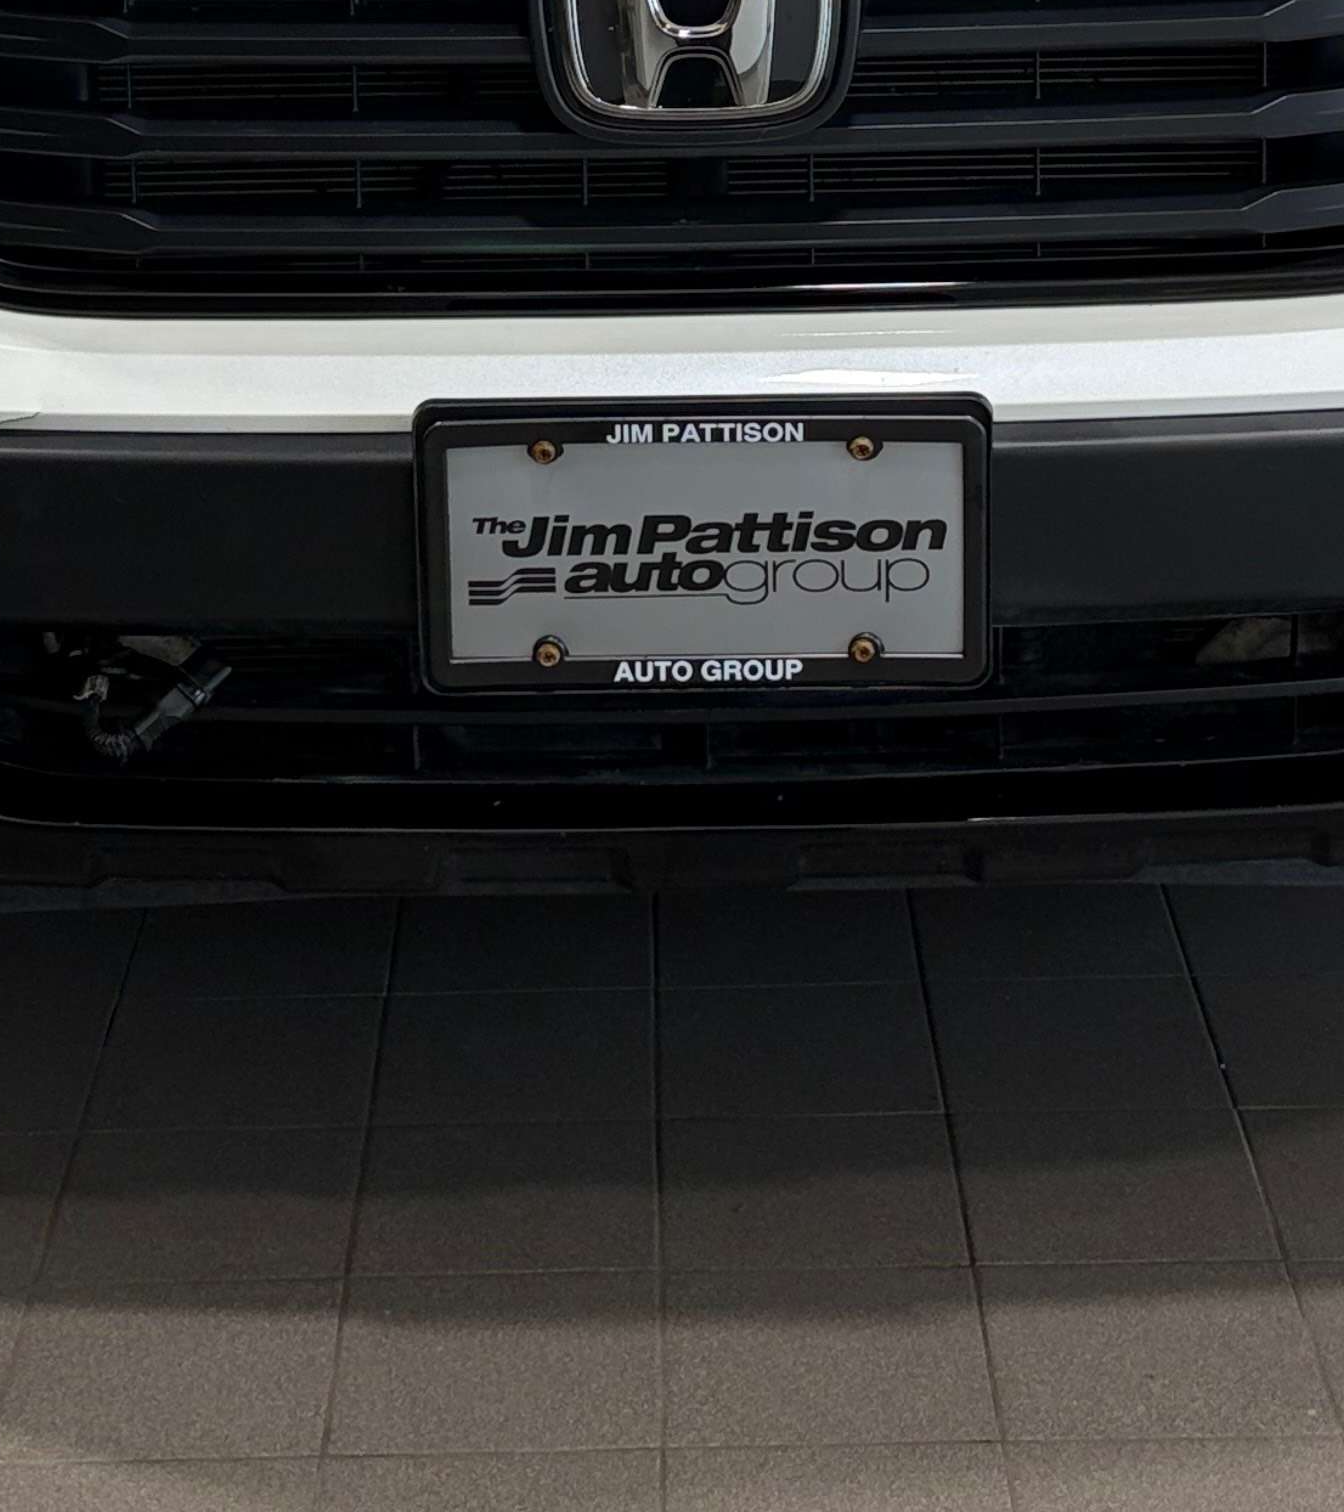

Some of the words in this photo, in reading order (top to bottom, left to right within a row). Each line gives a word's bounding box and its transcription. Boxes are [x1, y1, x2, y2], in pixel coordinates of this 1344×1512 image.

[606, 423, 653, 444] JIM
[662, 422, 804, 443] PATTISON
[472, 517, 526, 535] The
[502, 514, 632, 558] Jim
[636, 511, 948, 554] Pattison
[613, 660, 693, 683] AUTO
[700, 659, 803, 681] GROUP
